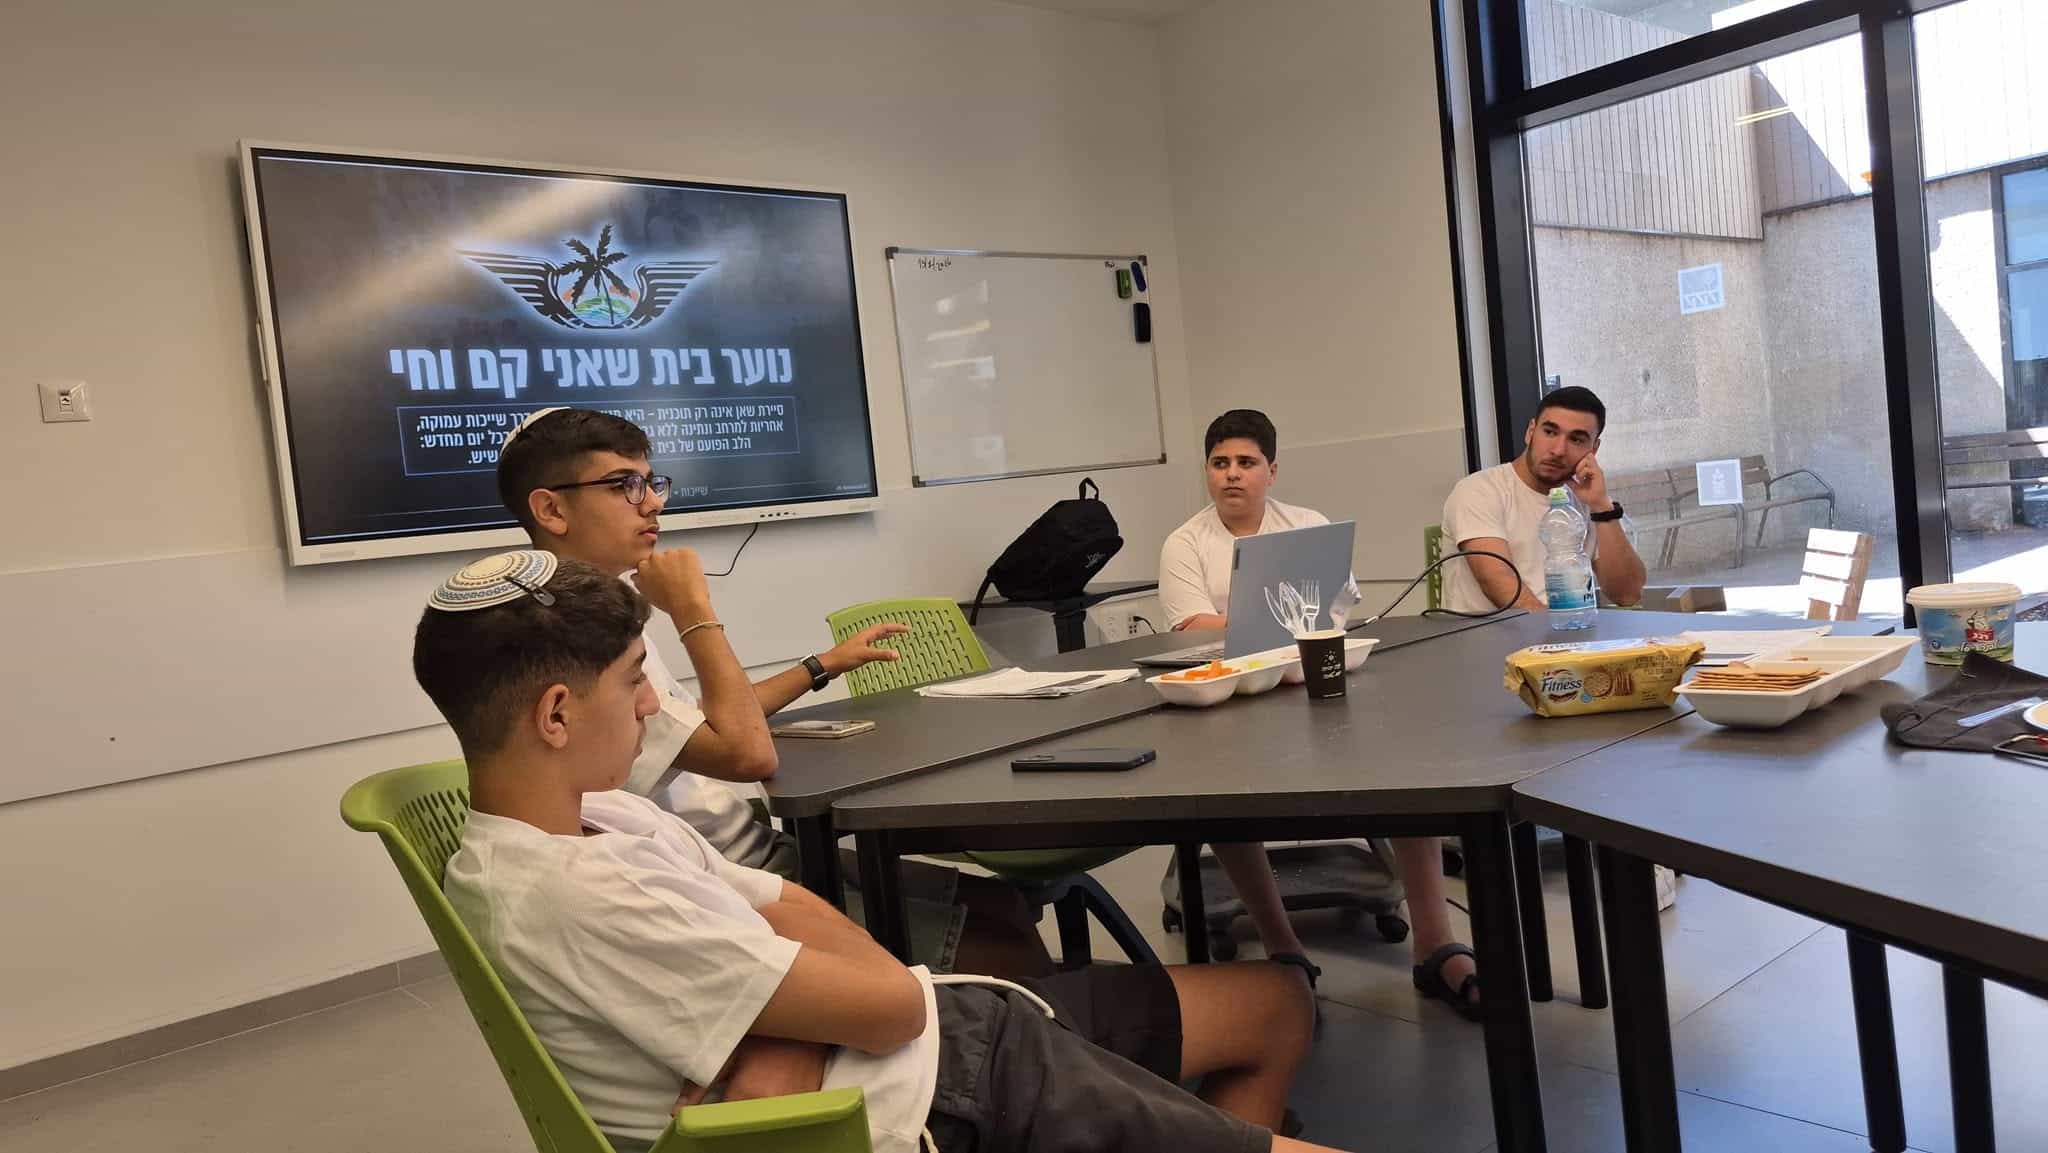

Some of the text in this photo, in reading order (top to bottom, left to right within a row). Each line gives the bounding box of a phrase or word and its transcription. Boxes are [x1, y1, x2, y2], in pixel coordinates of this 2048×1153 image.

[389, 348, 793, 399] נוער בית שאני קם וחי
[658, 408, 691, 420] תוכנית
[694, 408, 708, 421] רק
[711, 407, 733, 419] אינה
[736, 406, 754, 420] שאן
[758, 404, 784, 416] סיירת
[416, 416, 461, 432] עמוקה,
[467, 414, 507, 428] שייכות
[716, 421, 747, 434] למרחב
[750, 420, 784, 433] אחריות
[657, 423, 678, 436] ללא
[681, 424, 713, 435] ונתינה
[421, 433, 464, 448] מחדש:
[468, 433, 485, 446] יום
[678, 440, 694, 452] של
[697, 439, 729, 452] הפועם
[732, 437, 751, 450] הלב
[657, 441, 675, 454] בית
[1541, 677, 1582, 692] Fitness
